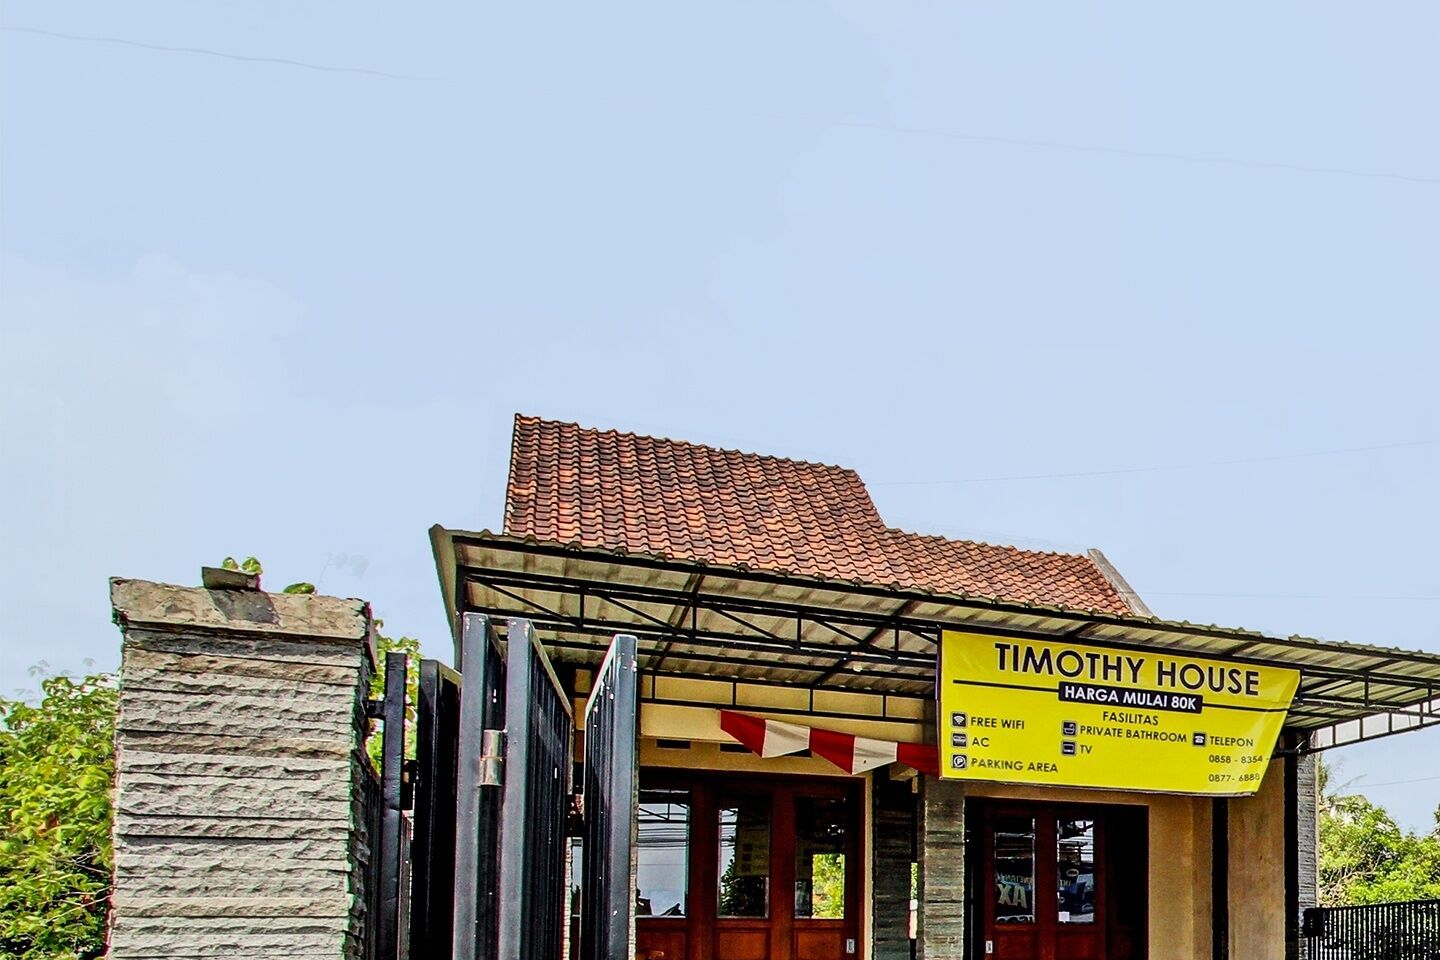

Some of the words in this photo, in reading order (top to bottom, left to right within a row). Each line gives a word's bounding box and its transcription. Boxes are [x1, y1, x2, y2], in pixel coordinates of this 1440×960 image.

[994, 643, 1145, 684] TIMOTHY
[1157, 660, 1259, 696] HOUSE
[1064, 685, 1119, 703] HARGA
[1122, 691, 1168, 708] MULAI
[1171, 697, 1197, 710] 80K
[970, 716, 997, 728] FREE
[1000, 719, 1025, 730] WIFI
[1102, 711, 1159, 726] FASILITAS
[1080, 725, 1123, 738] PRIVATE
[1125, 729, 1187, 743] BATHROOM
[1209, 735, 1254, 747] TELEPON
[971, 737, 990, 748] AC
[1080, 744, 1093, 754] TV
[970, 758, 1024, 771] PARKING
[1027, 762, 1059, 773] AREA
[1208, 754, 1232, 764] 0858
